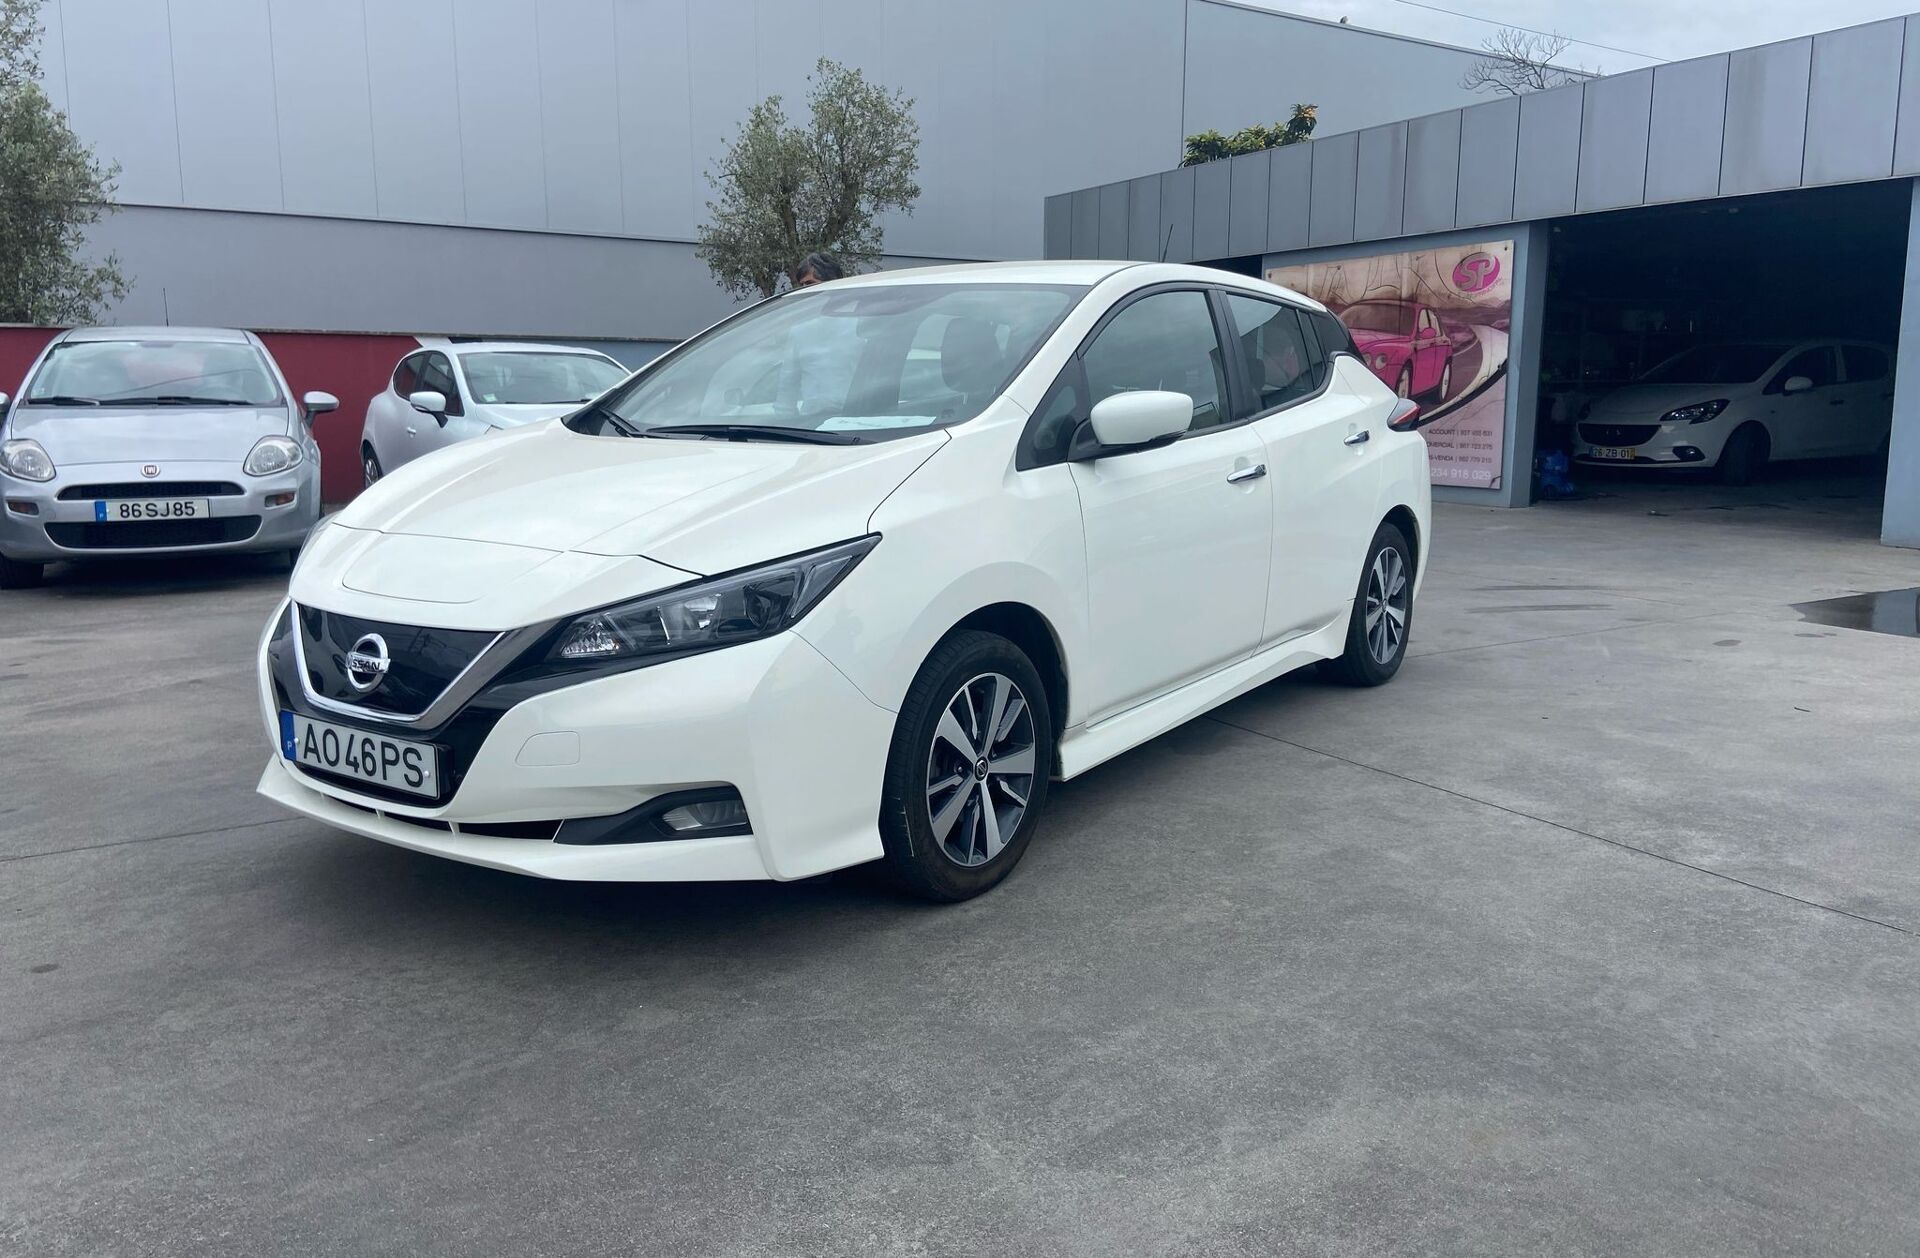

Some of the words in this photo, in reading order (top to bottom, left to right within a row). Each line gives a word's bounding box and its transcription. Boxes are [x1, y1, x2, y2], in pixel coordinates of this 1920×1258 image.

[1456, 252, 1496, 290] SP
[1428, 429, 1456, 437] ACCOUNT
[1431, 468, 1448, 478] 234
[346, 654, 381, 672] SSAN
[286, 740, 293, 751] P
